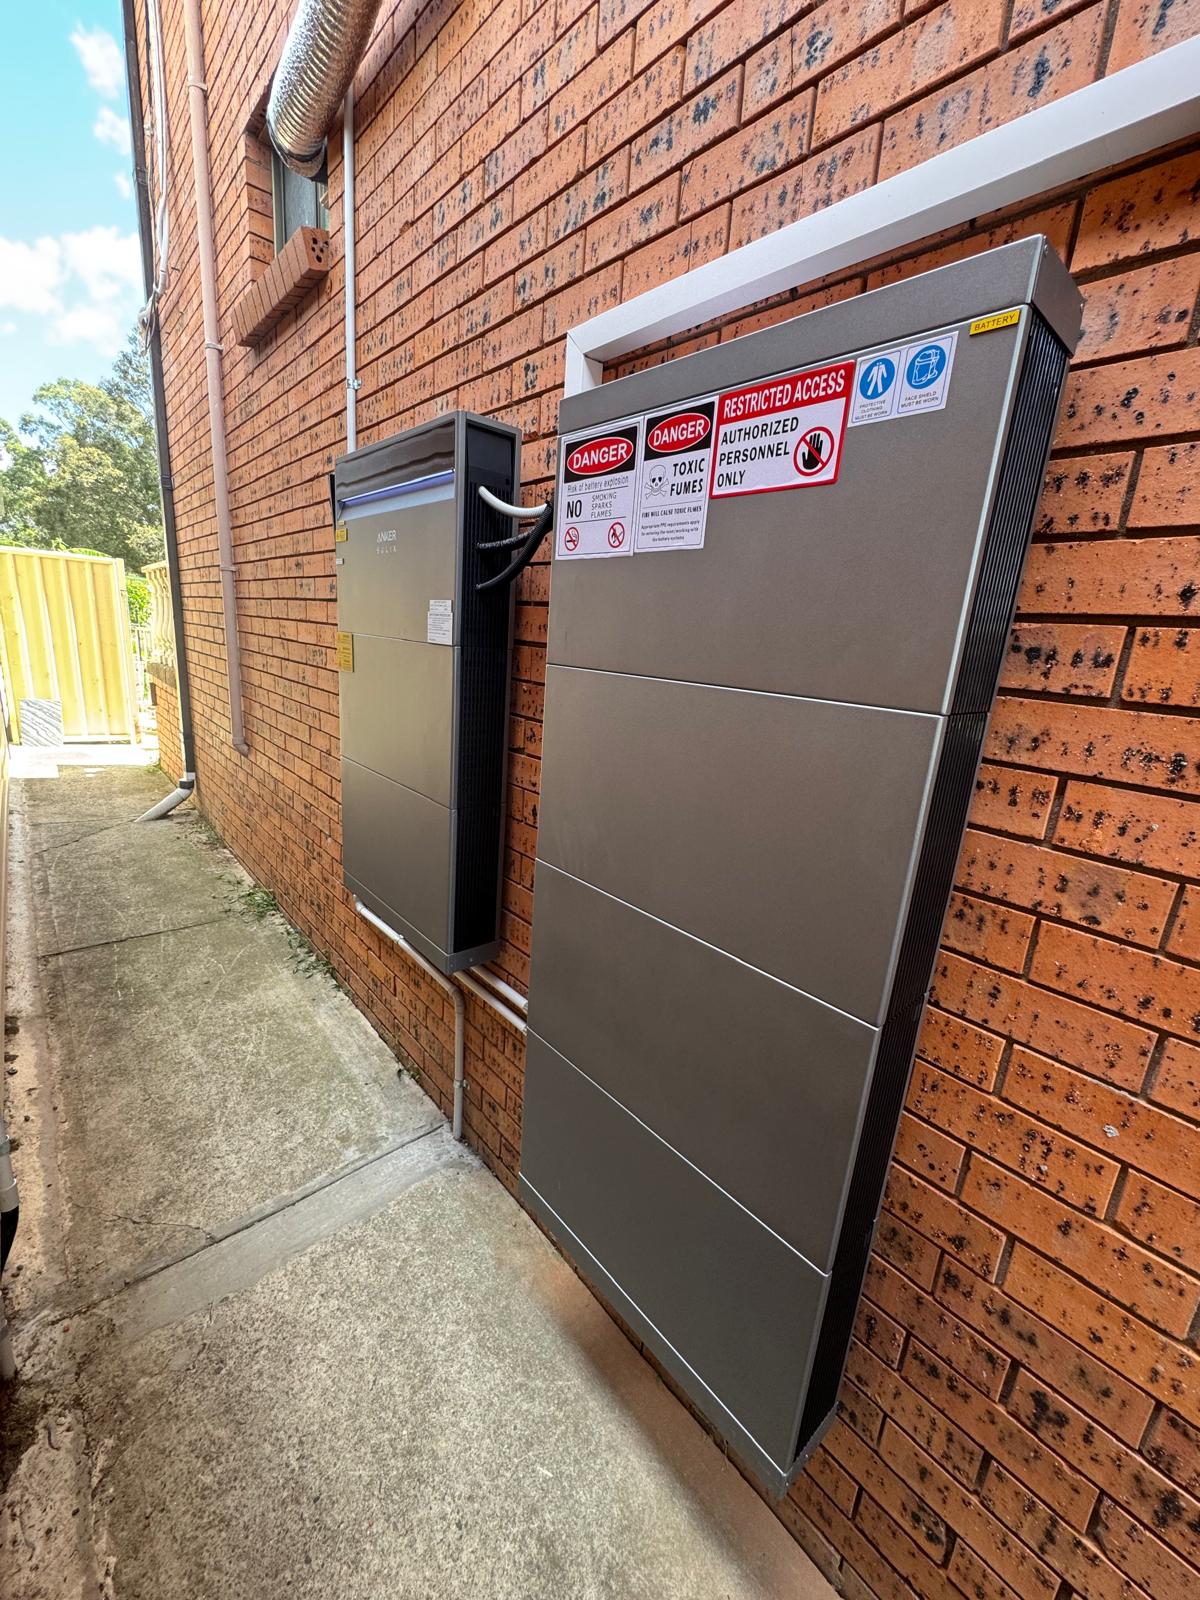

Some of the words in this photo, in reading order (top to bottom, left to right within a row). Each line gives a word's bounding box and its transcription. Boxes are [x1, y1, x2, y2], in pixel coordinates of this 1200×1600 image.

[974, 314, 1016, 331] BATTERY
[724, 384, 792, 419] RESTRICTED
[792, 369, 845, 402] ACCESS
[860, 400, 886, 408] PROTECTIVE
[653, 420, 705, 446] DANGER
[721, 416, 799, 446] AUTHORIZED
[573, 443, 627, 469] DANGER
[719, 441, 790, 466] PERSONNEL
[673, 458, 705, 476] TOXIC
[578, 483, 583, 491] of
[585, 480, 602, 491] battery
[604, 476, 628, 487] explosion
[670, 478, 703, 496] FUMES
[717, 470, 746, 488] ONLY
[592, 492, 617, 502] SMOKING
[592, 501, 612, 511] SPARKS
[566, 500, 582, 519] NO
[591, 510, 612, 518] FLAMES
[377, 530, 397, 543] ANKER
